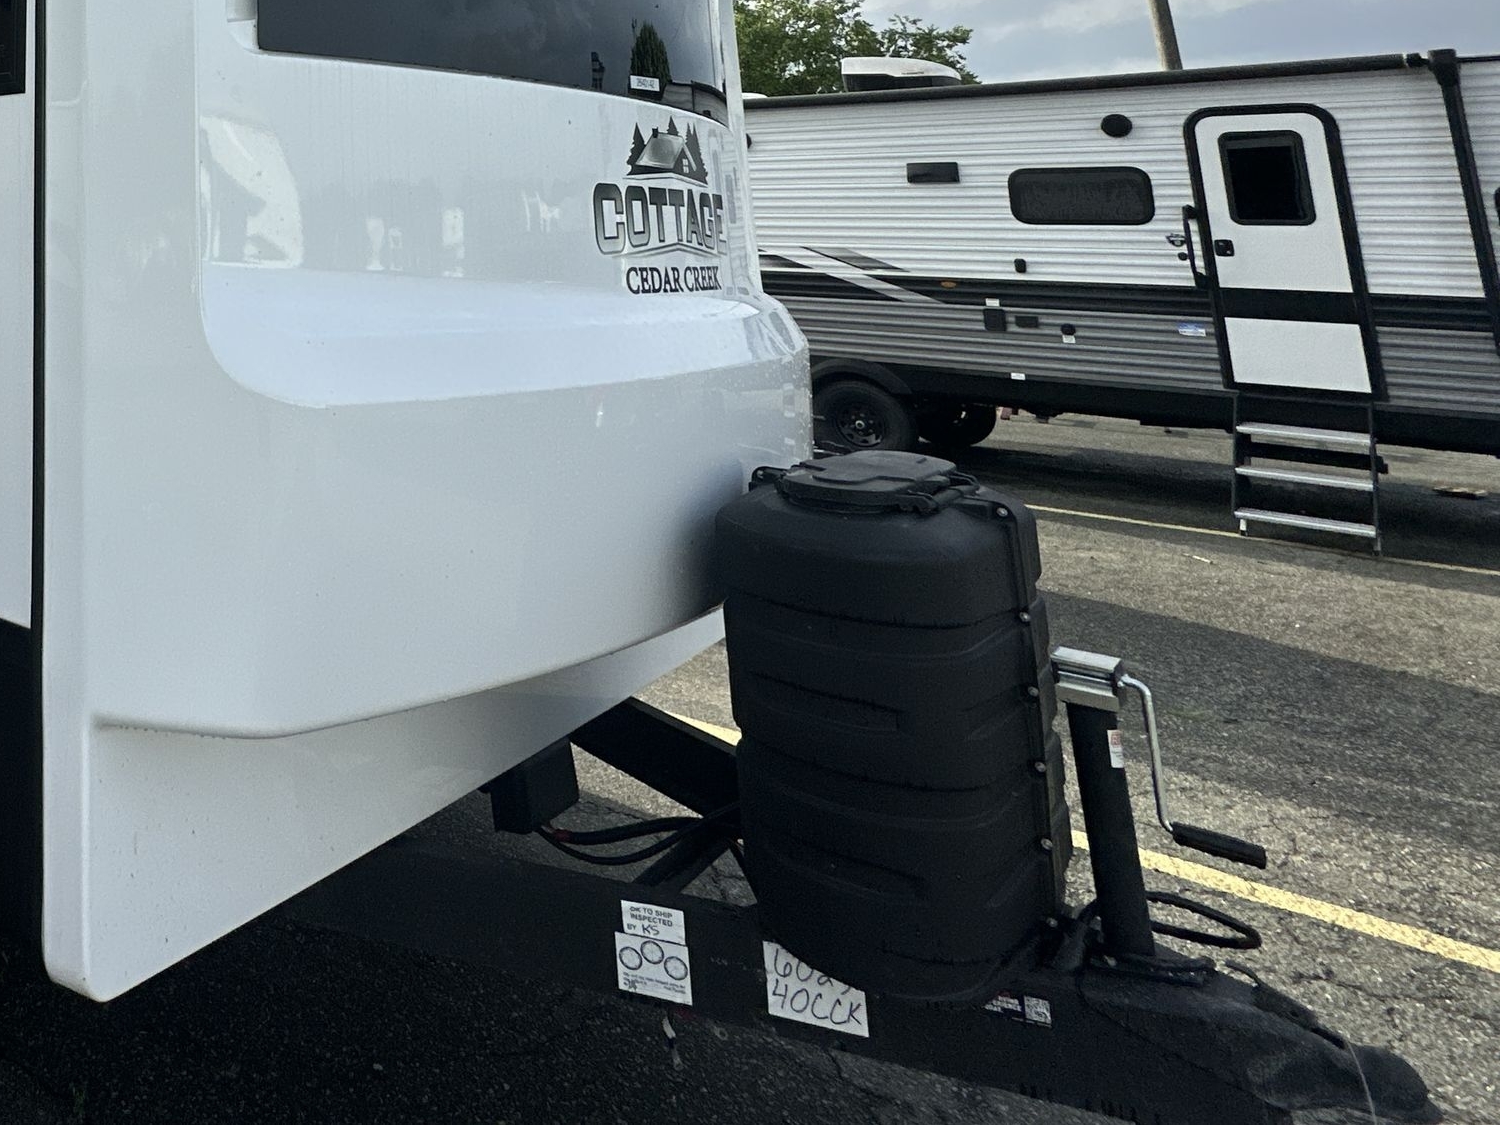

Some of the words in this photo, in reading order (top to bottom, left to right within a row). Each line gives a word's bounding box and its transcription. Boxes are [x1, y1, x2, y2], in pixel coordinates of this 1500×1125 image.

[593, 182, 728, 256] COTTAGE
[626, 266, 684, 295] CEDAR
[683, 265, 723, 292] CREEK
[630, 912, 673, 927] INSPECTED
[643, 907, 654, 916] TO
[655, 909, 673, 919] SHIP
[641, 923, 660, 936] KS
[772, 978, 862, 1025] 40CCK
